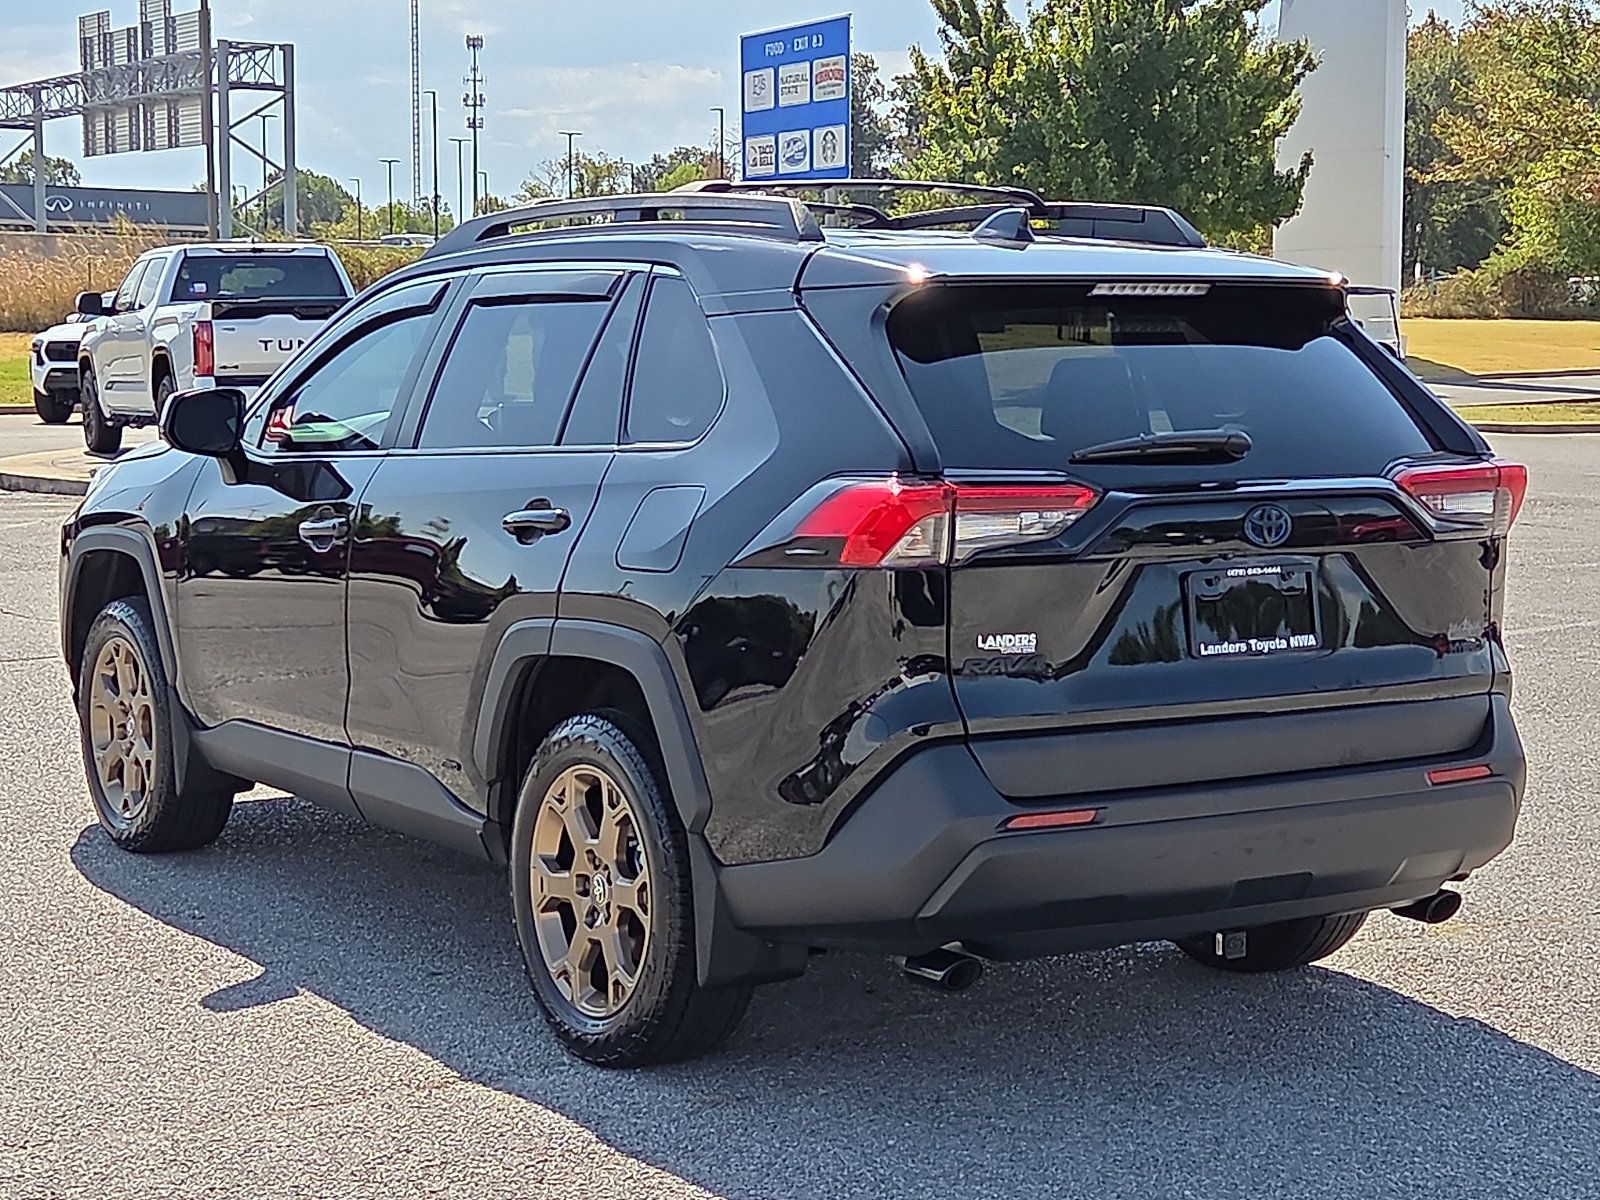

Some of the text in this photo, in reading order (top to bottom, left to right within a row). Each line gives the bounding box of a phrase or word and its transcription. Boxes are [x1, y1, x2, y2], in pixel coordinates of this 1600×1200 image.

[765, 41, 785, 56] FOOD
[793, 36, 809, 52] EXIT
[780, 73, 808, 85] NATURAL
[780, 86, 799, 96] STATE
[758, 144, 774, 155] TACO
[759, 155, 774, 167] BELL
[78, 200, 151, 210] INFINITI
[977, 633, 1037, 649] LANDERS
[1200, 633, 1317, 656] Landers Toyota NWA
[962, 655, 1047, 677] RAV4
